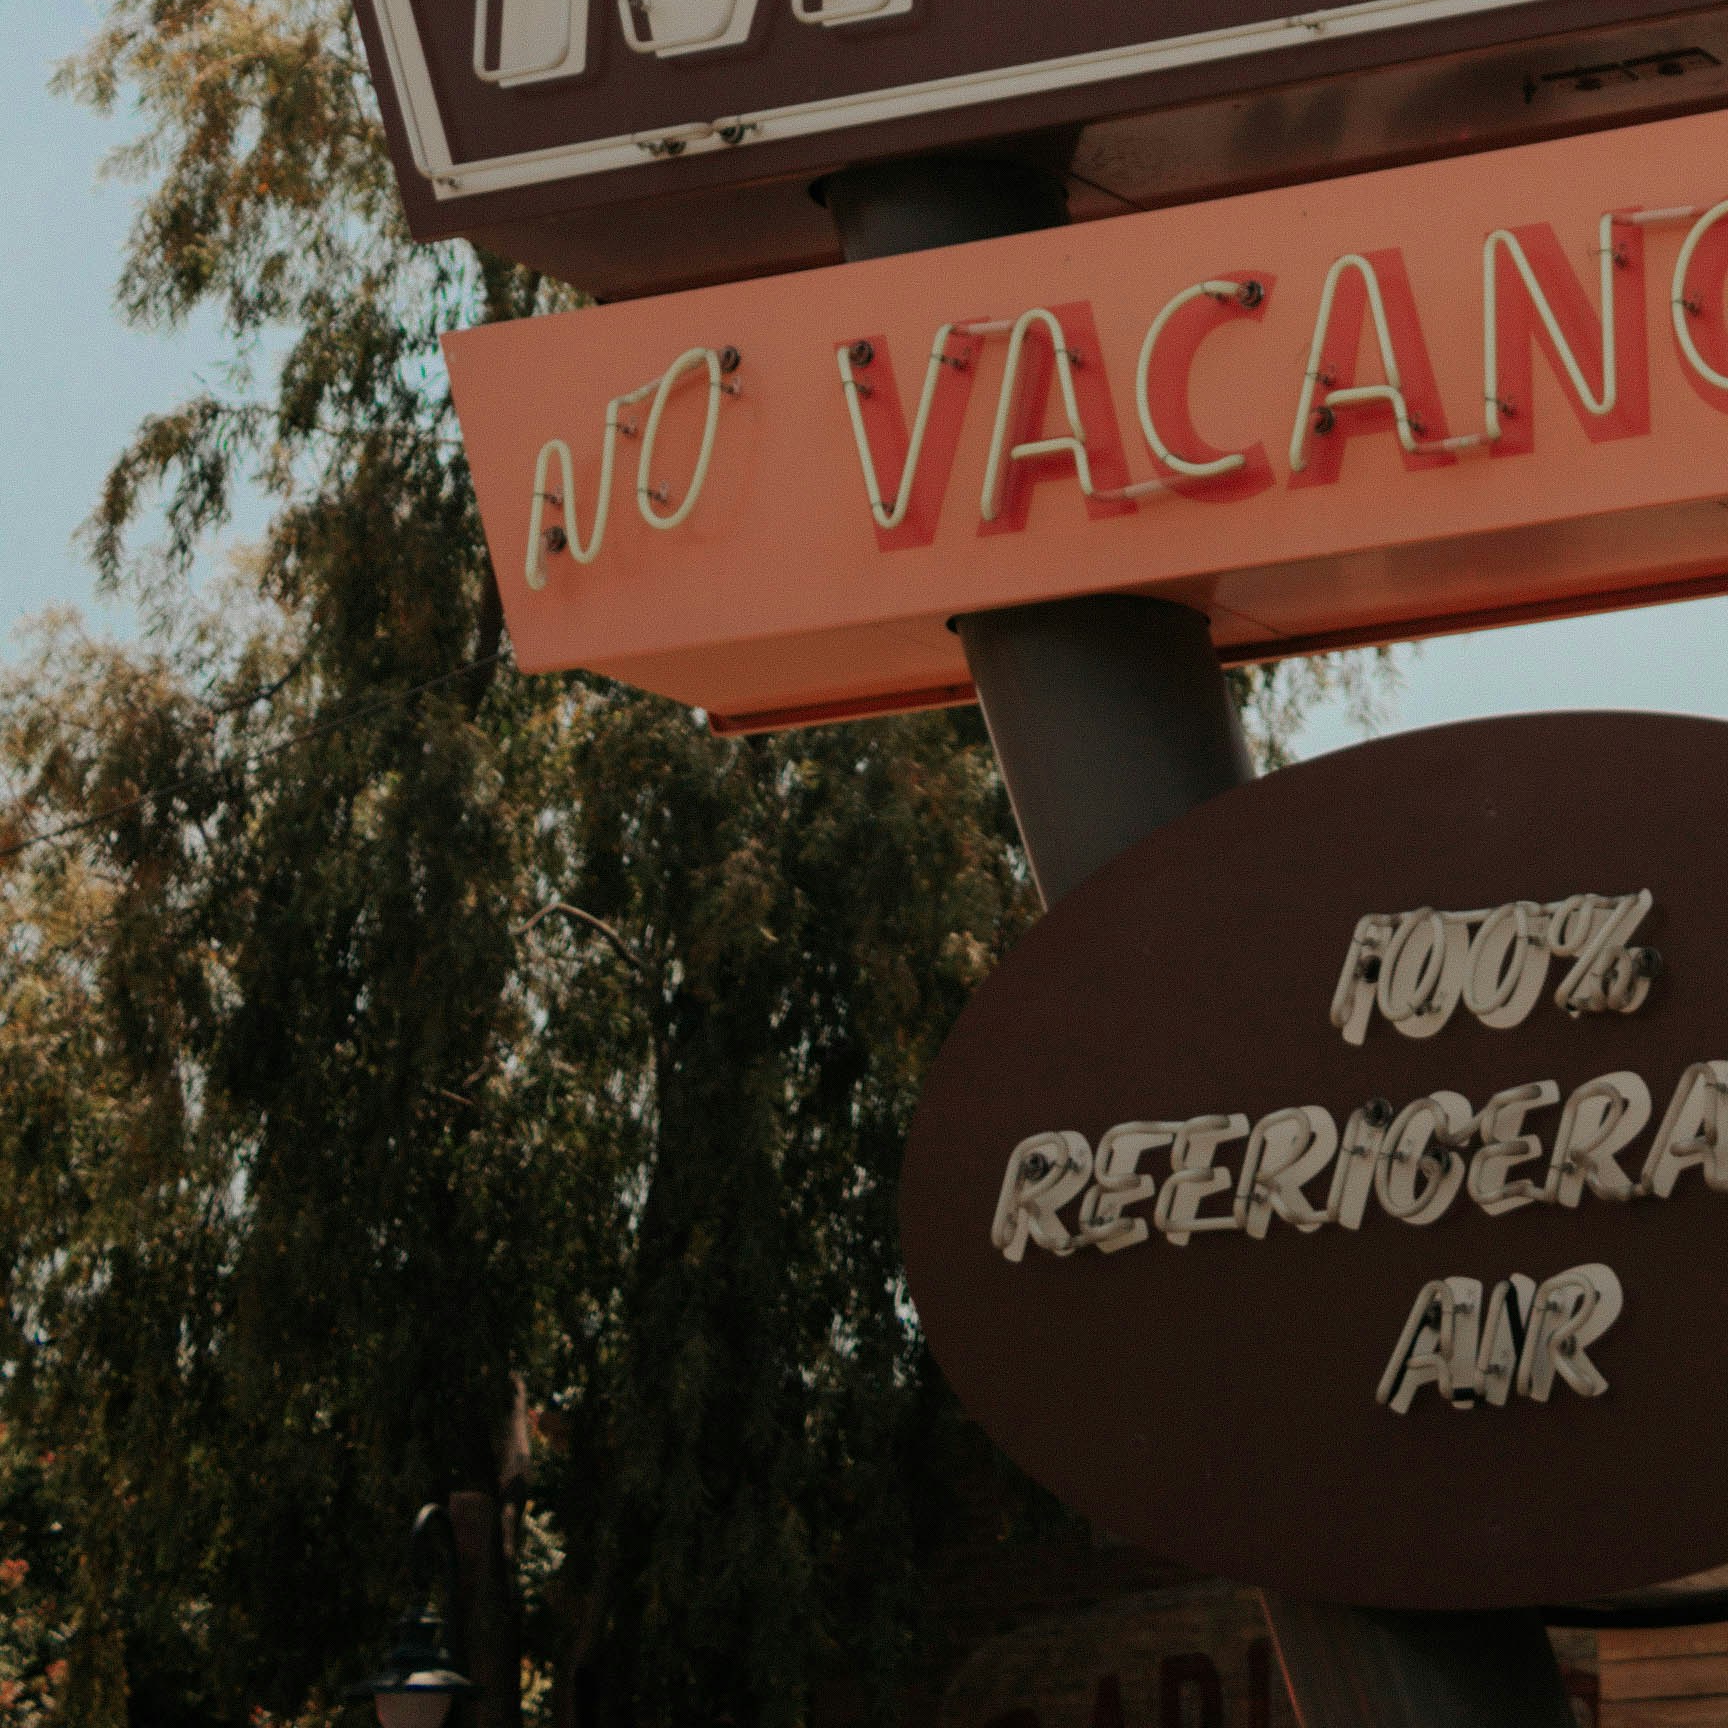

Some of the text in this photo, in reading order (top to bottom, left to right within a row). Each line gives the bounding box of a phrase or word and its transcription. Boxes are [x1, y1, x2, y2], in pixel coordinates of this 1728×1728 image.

[525, 344, 741, 590] NO
[1330, 888, 1662, 1046] 100%
[1376, 1263, 1622, 1414] AIR
